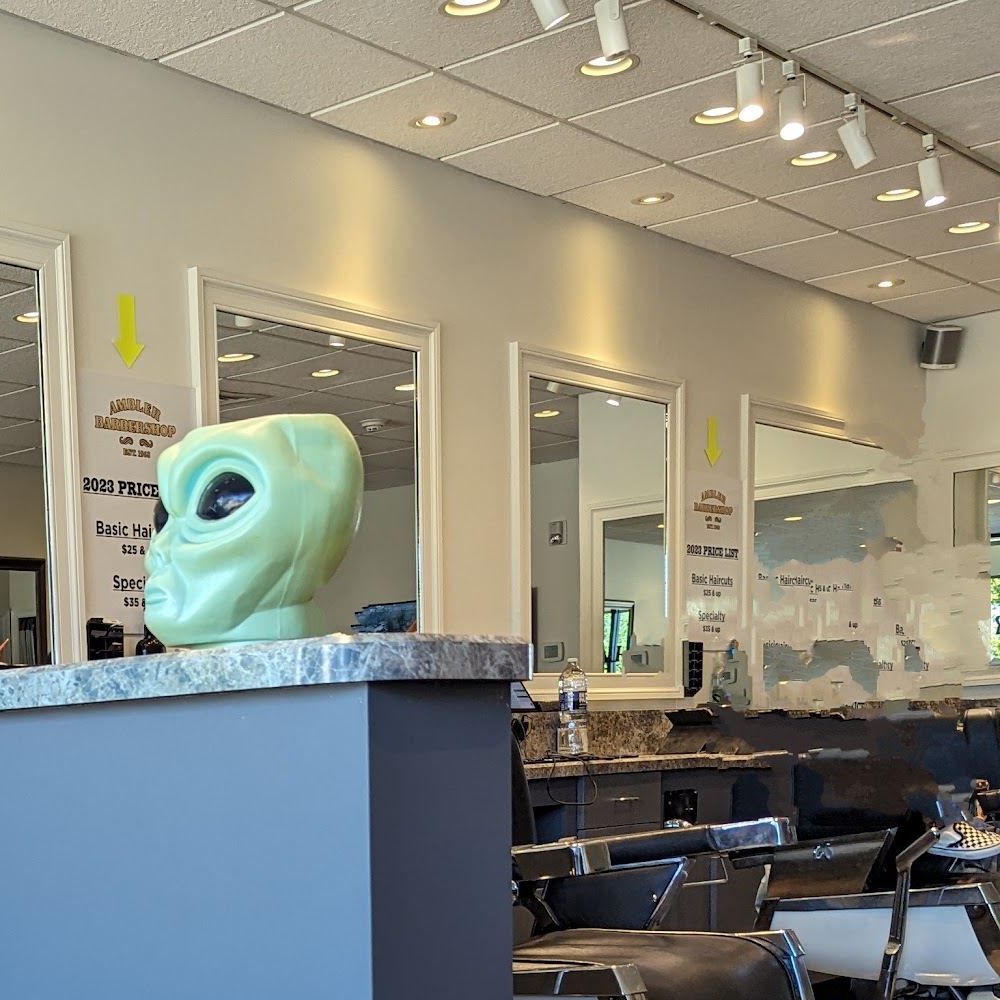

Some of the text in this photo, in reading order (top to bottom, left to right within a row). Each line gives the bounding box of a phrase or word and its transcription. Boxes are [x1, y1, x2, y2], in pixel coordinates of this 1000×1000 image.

[109, 398, 161, 422] AMBLER
[94, 415, 176, 437] BARBERSHOP
[83, 477, 159, 498] 2023 PRICE
[96, 520, 152, 538] Basic Hai
[121, 544, 138, 555] $25
[703, 545, 724, 557] PRICE
[725, 548, 739, 559] LIST
[113, 575, 146, 591] Speci
[692, 573, 733, 586] Basic Haircuts
[124, 597, 139, 607] $35
[698, 611, 726, 623] Specialty
